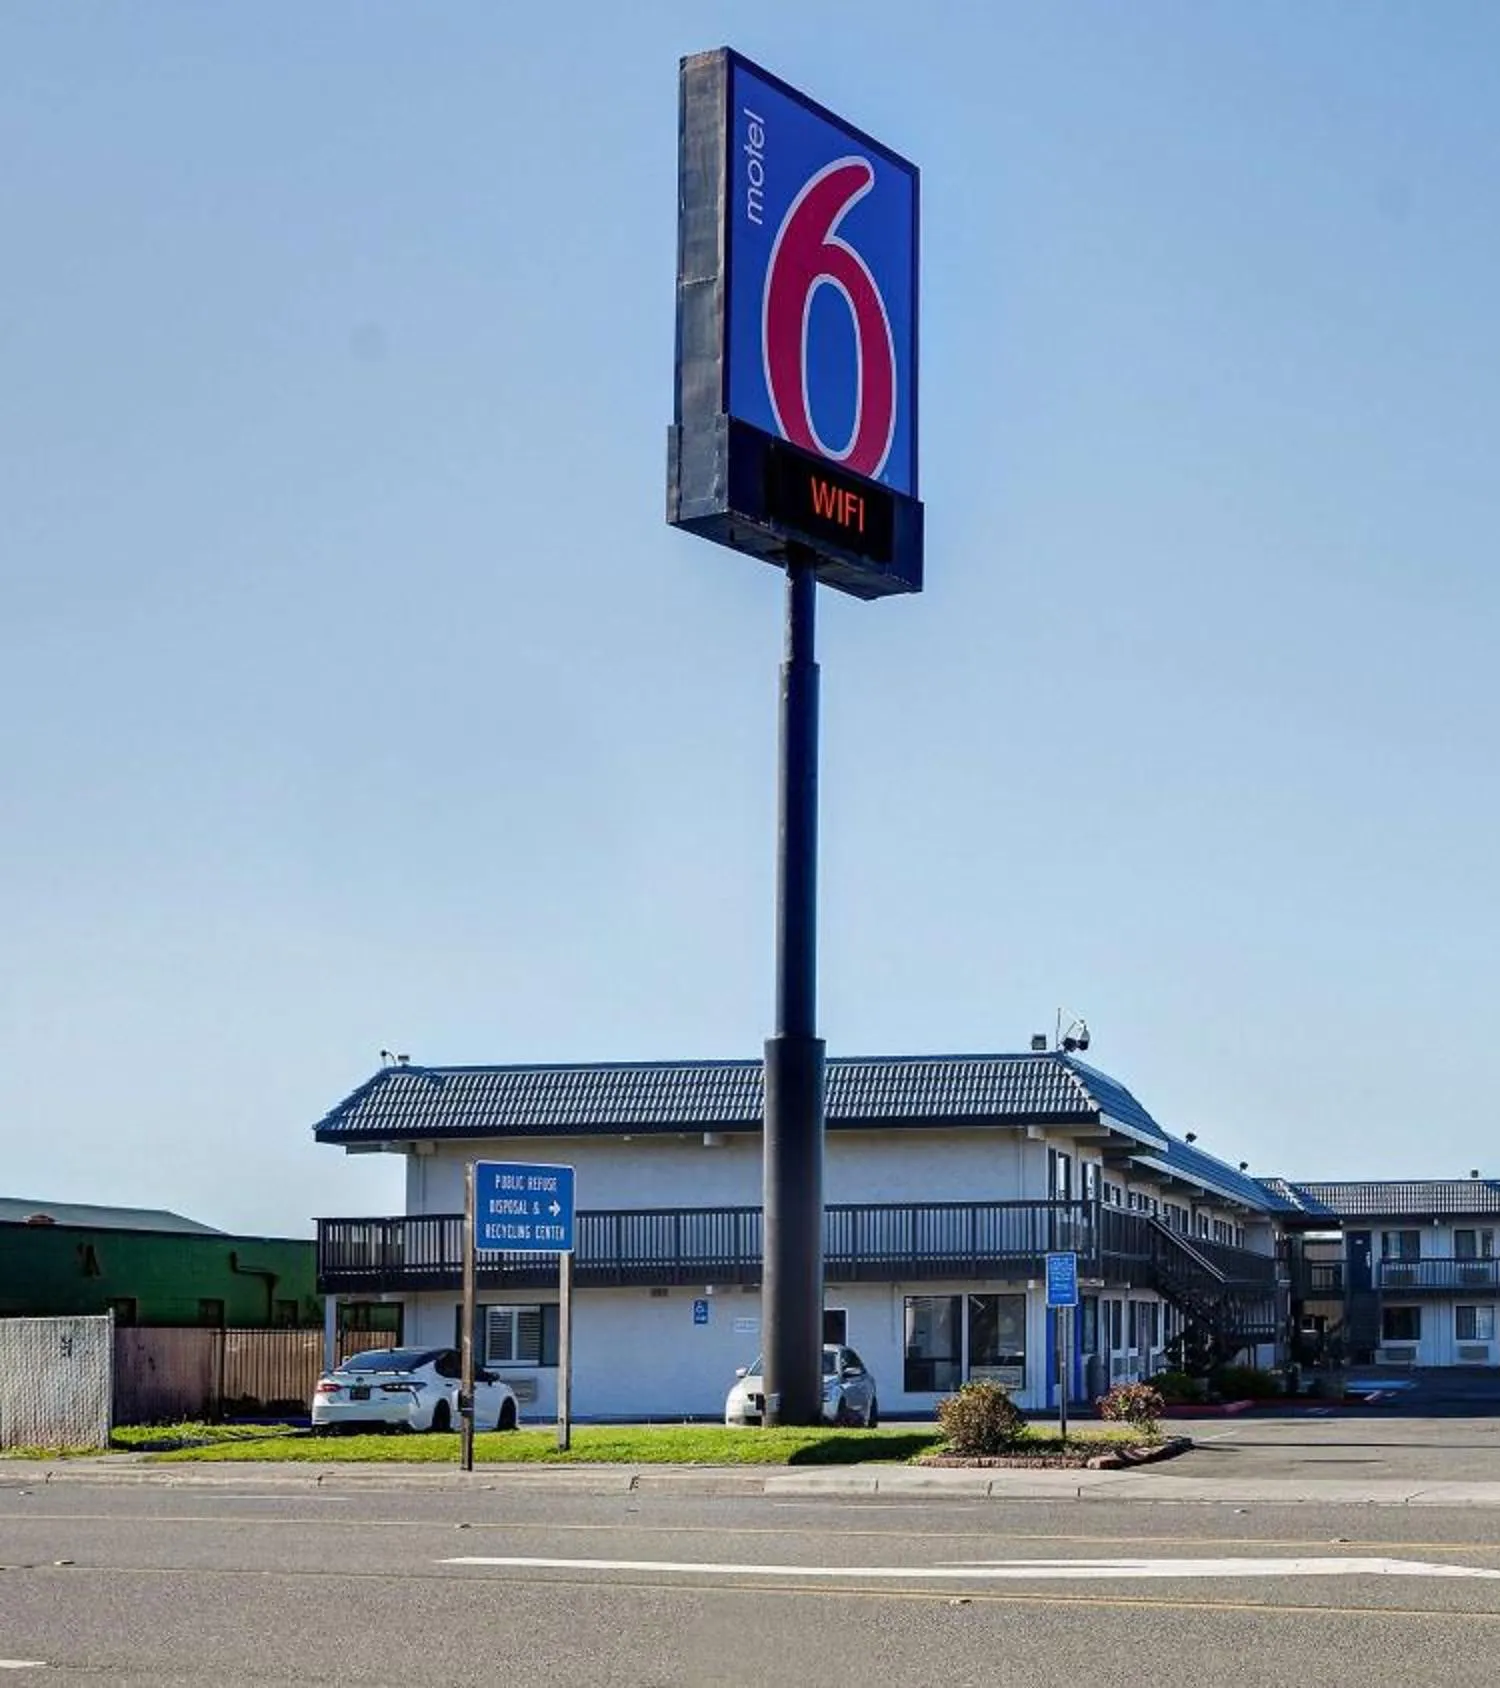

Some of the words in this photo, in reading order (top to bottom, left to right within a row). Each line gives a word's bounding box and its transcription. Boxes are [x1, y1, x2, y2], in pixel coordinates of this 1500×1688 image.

[743, 109, 766, 225] motel
[762, 156, 896, 479] 6
[811, 476, 866, 532] WIFI
[495, 1174, 526, 1190] PUBLIC
[527, 1176, 557, 1191] REFUSE
[489, 1199, 529, 1215] DISPOSAL
[485, 1223, 531, 1239] RECYCLING
[535, 1225, 565, 1241] CENTER
